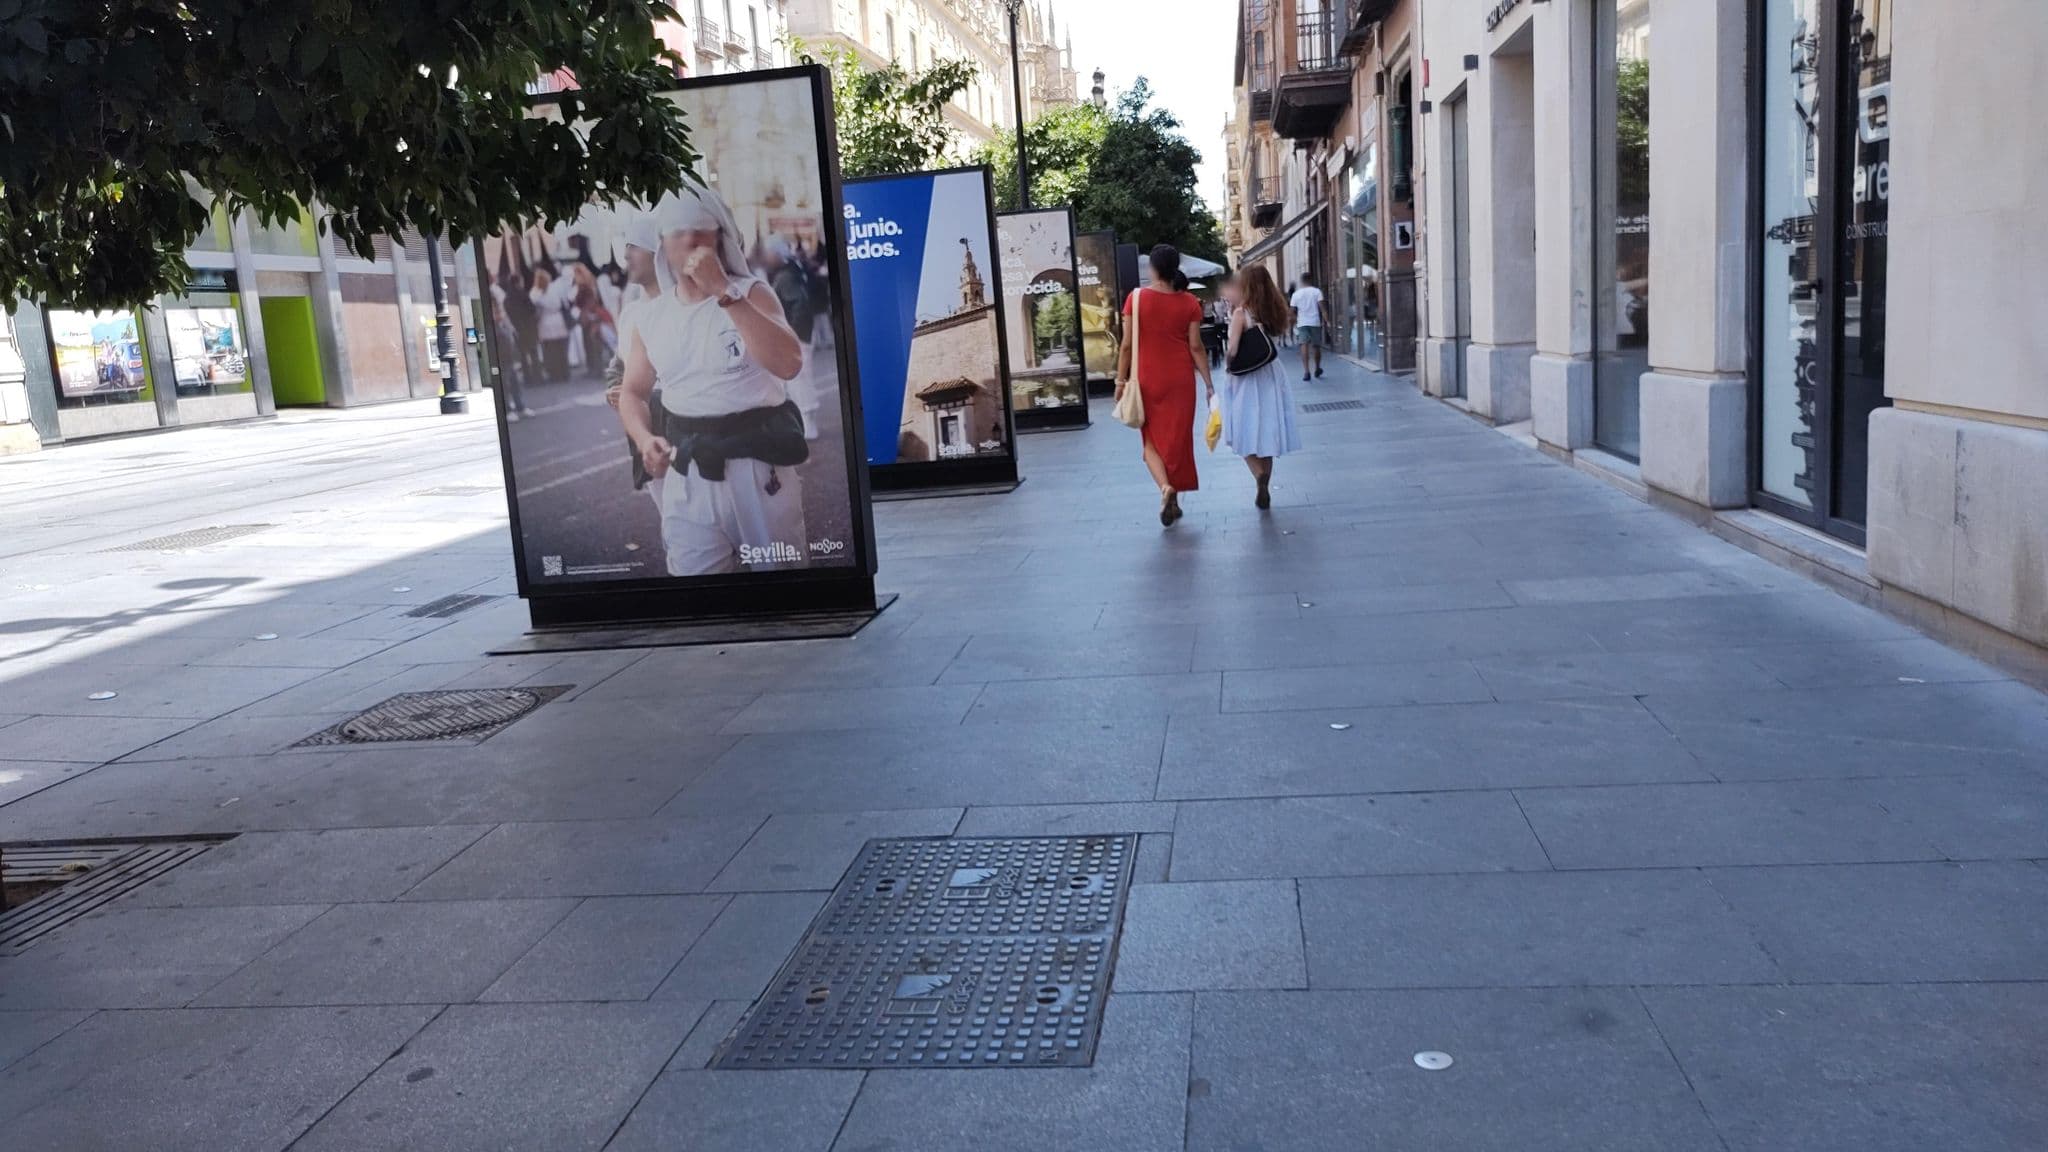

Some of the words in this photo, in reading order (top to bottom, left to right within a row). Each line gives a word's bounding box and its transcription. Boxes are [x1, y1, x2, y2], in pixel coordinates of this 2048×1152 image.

[843, 203, 861, 219] a.
[848, 217, 903, 244] junio.
[847, 239, 900, 260] ados.
[740, 542, 801, 559] Sevilla.
